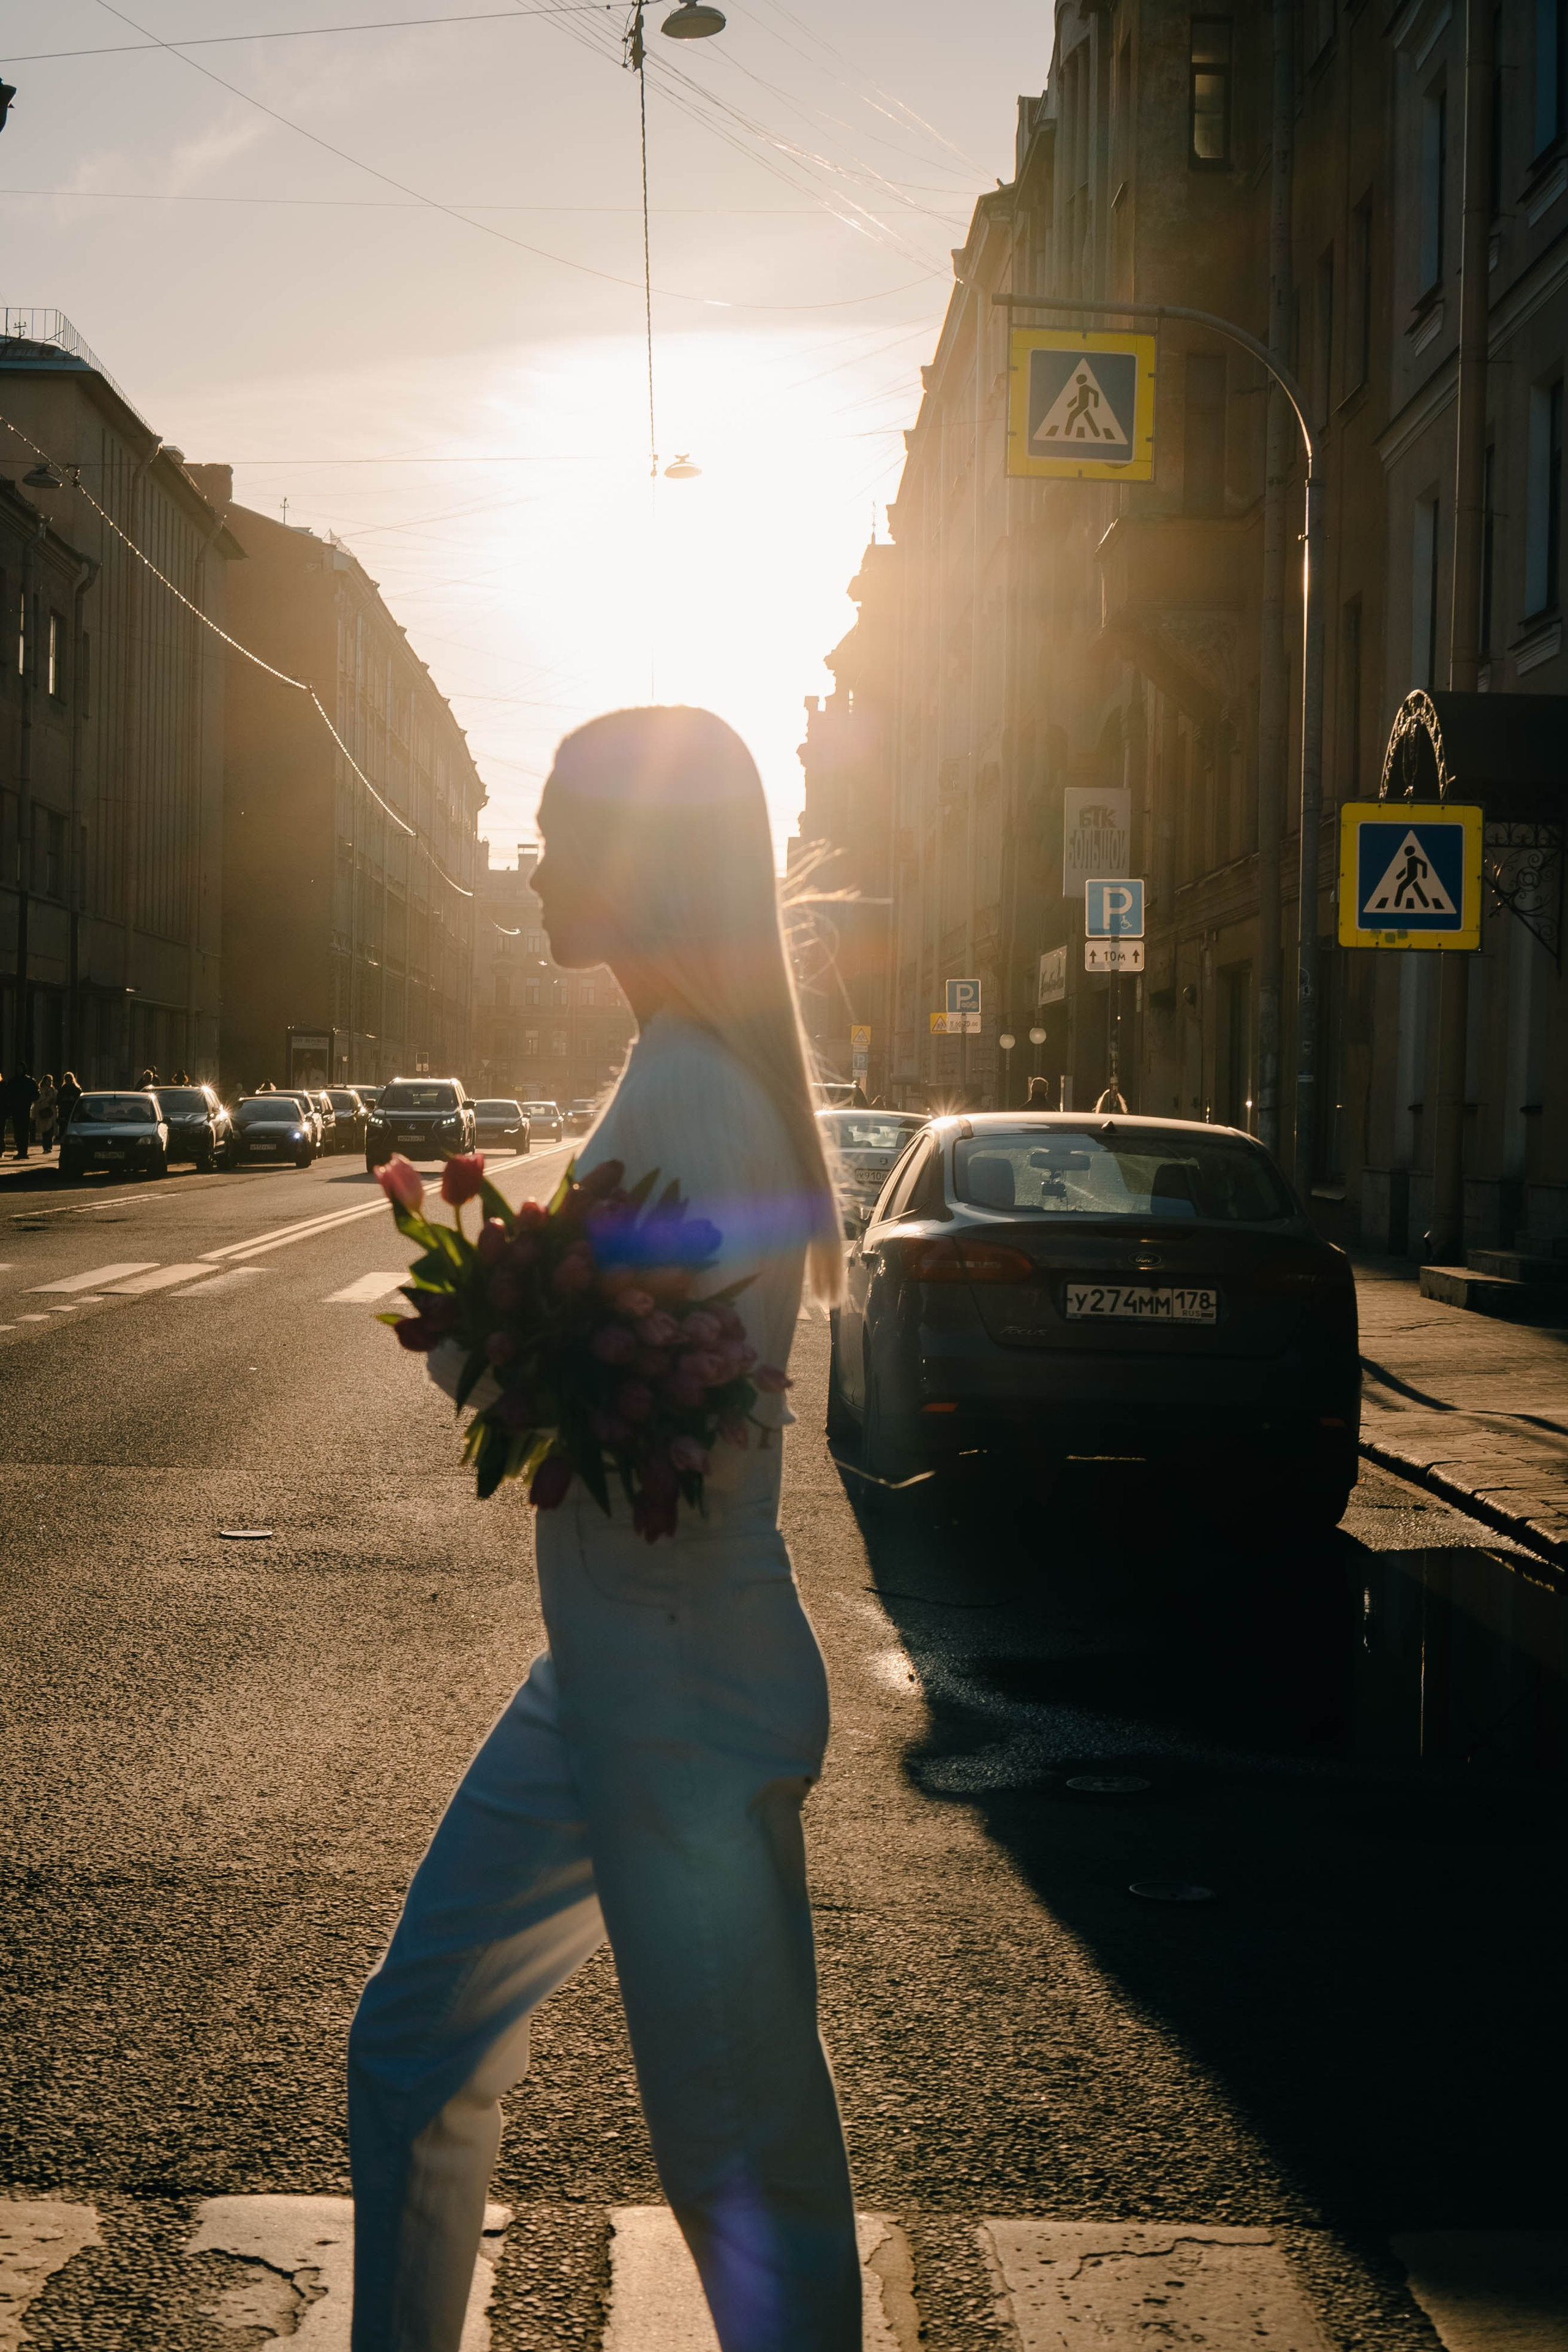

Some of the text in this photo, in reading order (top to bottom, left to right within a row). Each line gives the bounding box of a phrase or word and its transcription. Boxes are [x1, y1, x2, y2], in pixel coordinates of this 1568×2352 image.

[1079, 805, 1117, 828] БТК
[1103, 887, 1133, 930] P
[956, 984, 974, 1009] P
[1175, 1291, 1210, 1310] 178
